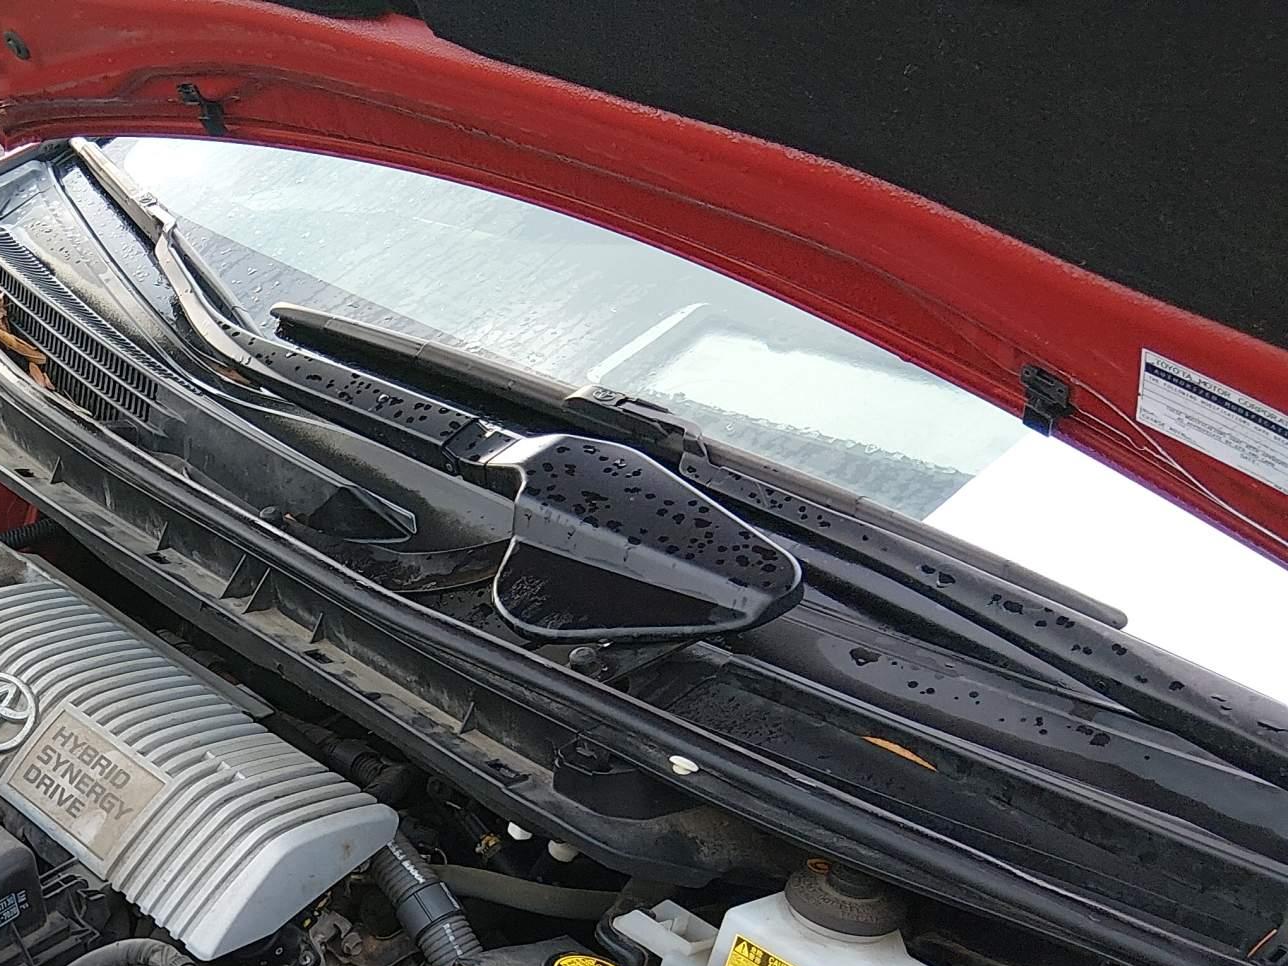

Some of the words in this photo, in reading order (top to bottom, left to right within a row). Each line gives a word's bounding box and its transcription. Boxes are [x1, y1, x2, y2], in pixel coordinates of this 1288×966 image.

[1156, 359, 1193, 382] TOYOTA
[1197, 378, 1231, 399] MOTOR
[36, 744, 134, 820] SYNERGY
[51, 725, 132, 790] HYBRID
[22, 763, 86, 819] DRIVE
